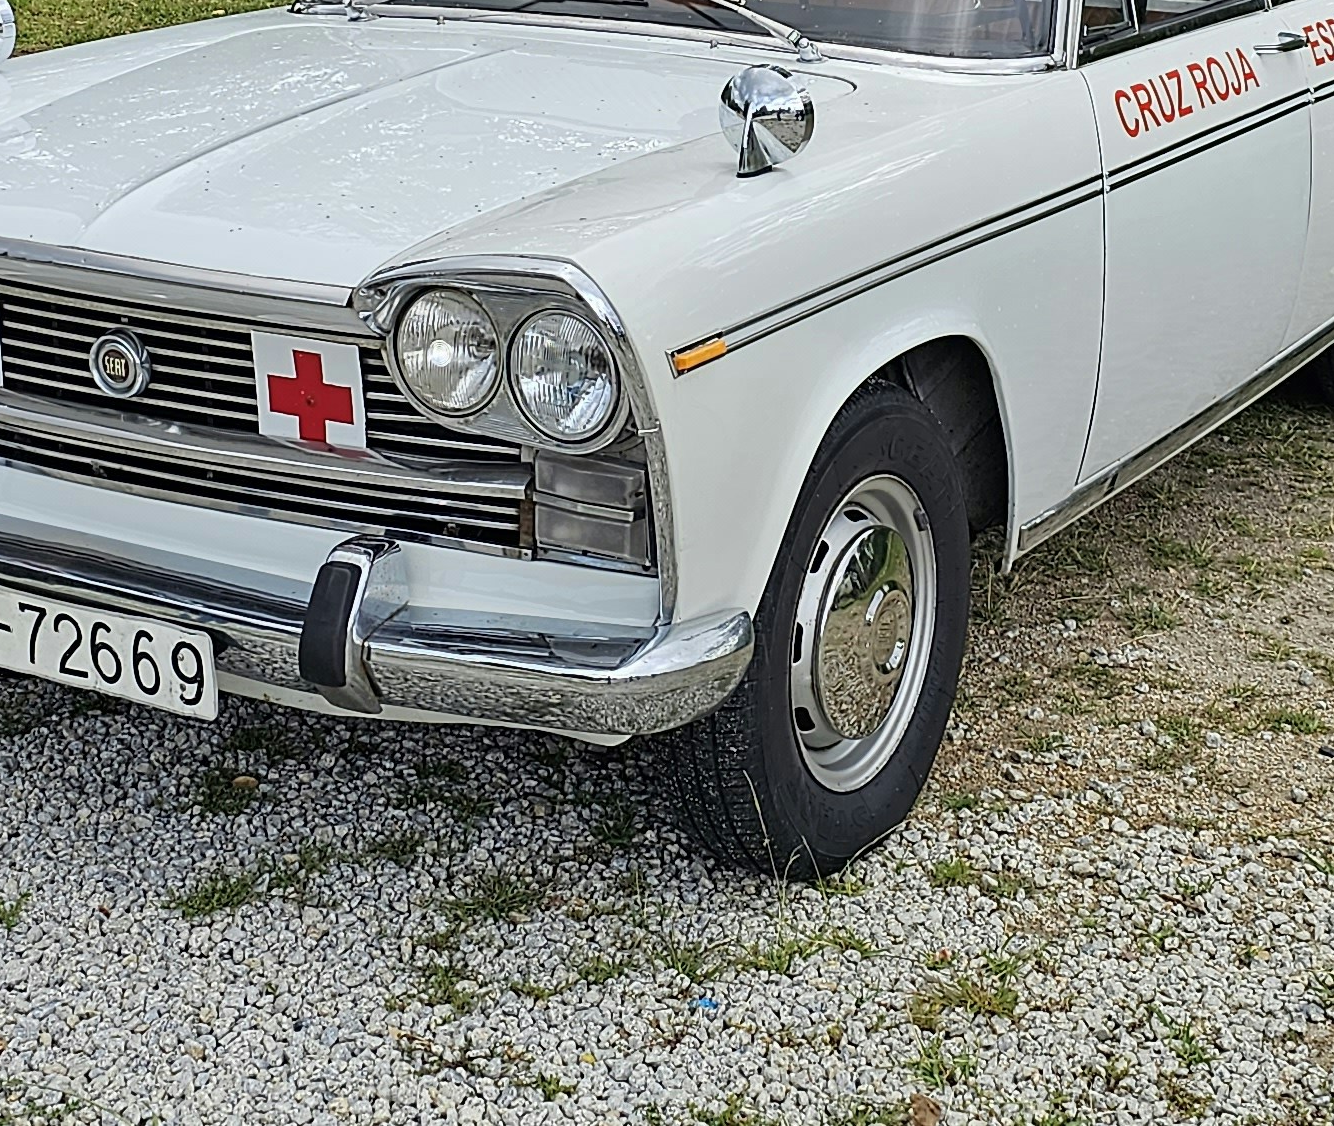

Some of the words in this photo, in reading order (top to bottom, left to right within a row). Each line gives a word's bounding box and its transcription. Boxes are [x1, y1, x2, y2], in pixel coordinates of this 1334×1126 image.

[1114, 69, 1194, 138] CRUZ
[1186, 47, 1261, 108] ROJA
[104, 355, 126, 378] SEAT
